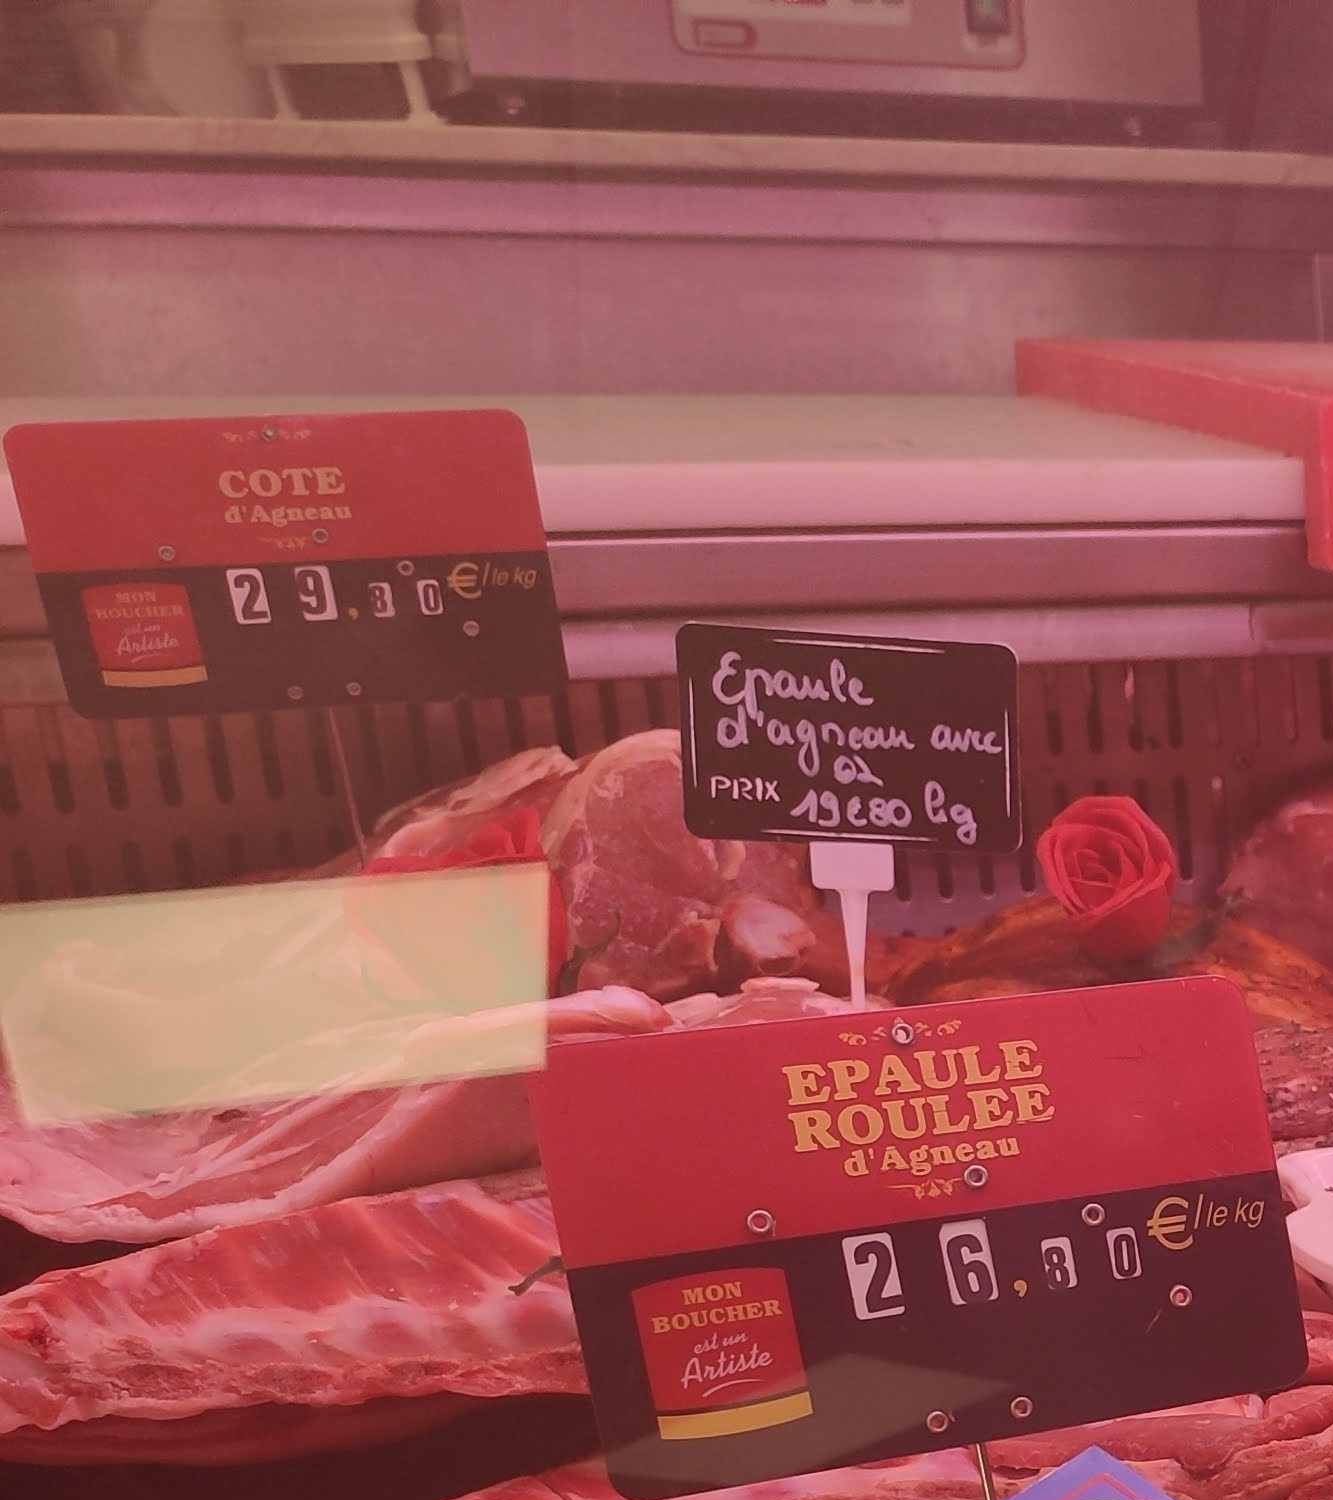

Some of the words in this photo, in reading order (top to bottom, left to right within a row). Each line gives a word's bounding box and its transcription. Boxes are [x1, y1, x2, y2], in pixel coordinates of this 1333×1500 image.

[219, 467, 346, 498] COTE
[224, 503, 352, 528] d'Agneau
[115, 591, 156, 604] MON
[95, 604, 184, 621] BOUCHER
[710, 775, 780, 802] PRIX
[781, 1039, 1044, 1107] EPAULE
[787, 1082, 1056, 1153] ROULEE
[842, 1135, 1020, 1178] d'Agneau
[1234, 1199, 1265, 1227] kg
[682, 1282, 742, 1305] MON
[652, 1300, 783, 1333] BOUCHER
[694, 1332, 718, 1354] est
[723, 1332, 748, 1347] un
[681, 1344, 773, 1390] Artiste
